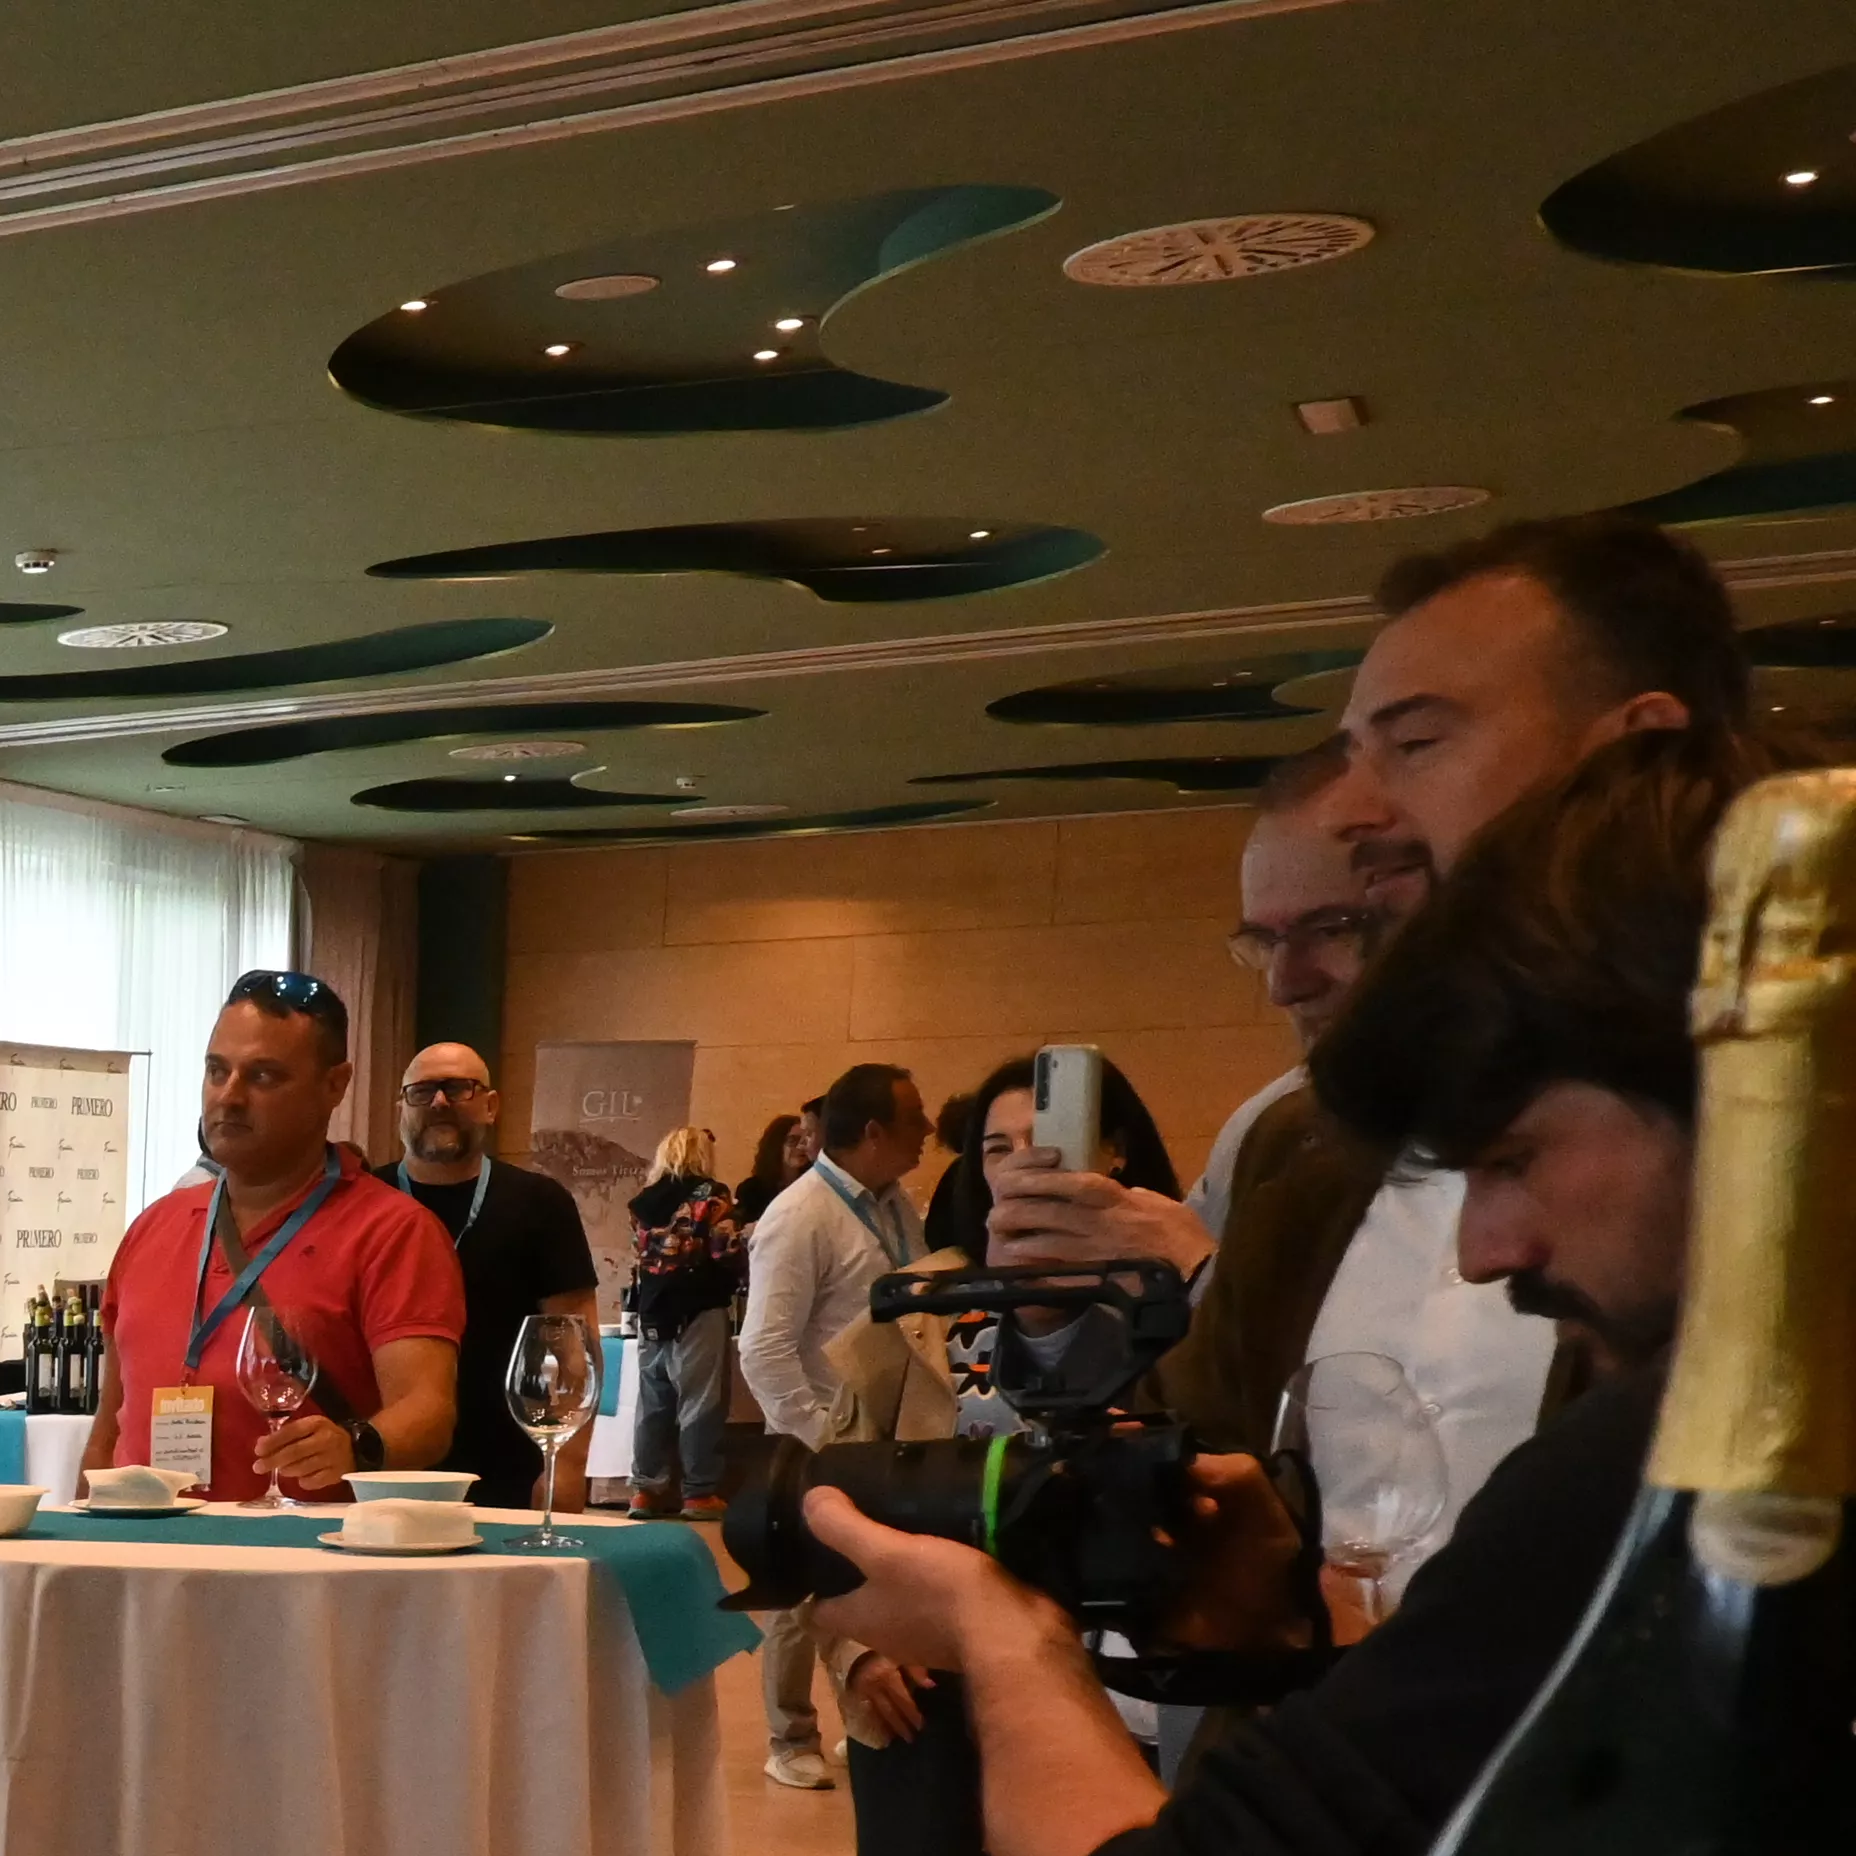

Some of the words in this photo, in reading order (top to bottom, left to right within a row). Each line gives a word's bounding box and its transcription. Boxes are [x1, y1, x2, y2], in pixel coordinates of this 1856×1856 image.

[71, 1096, 113, 1117] PRIMERO
[582, 1090, 634, 1117] GIL
[16, 1229, 62, 1248] PRIMERO
